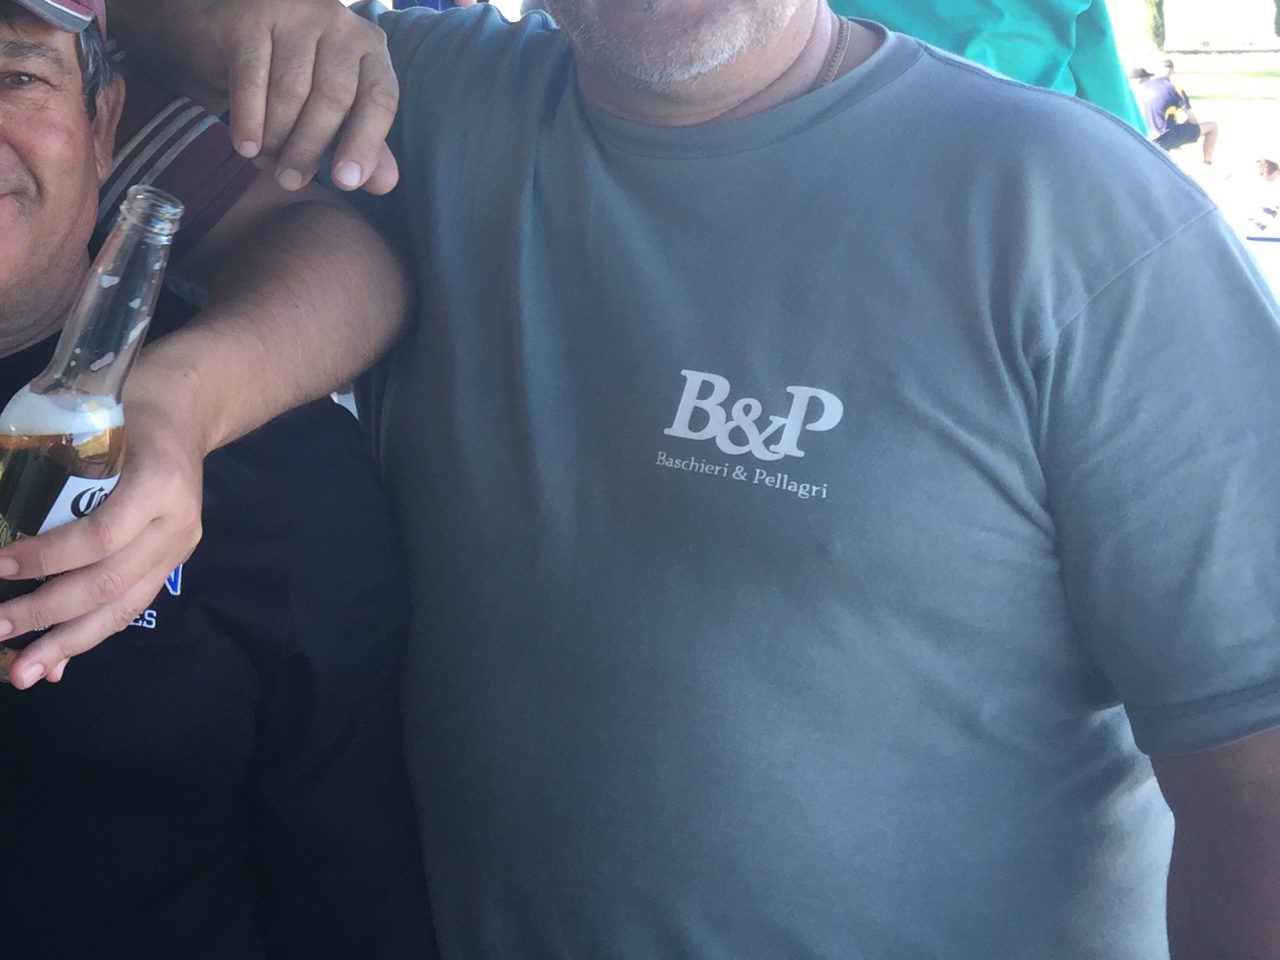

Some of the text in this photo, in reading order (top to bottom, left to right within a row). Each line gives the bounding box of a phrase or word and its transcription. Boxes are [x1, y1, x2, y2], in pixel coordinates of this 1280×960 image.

[663, 369, 844, 461] B&P
[655, 451, 828, 500] Baschieri & Pellagri
